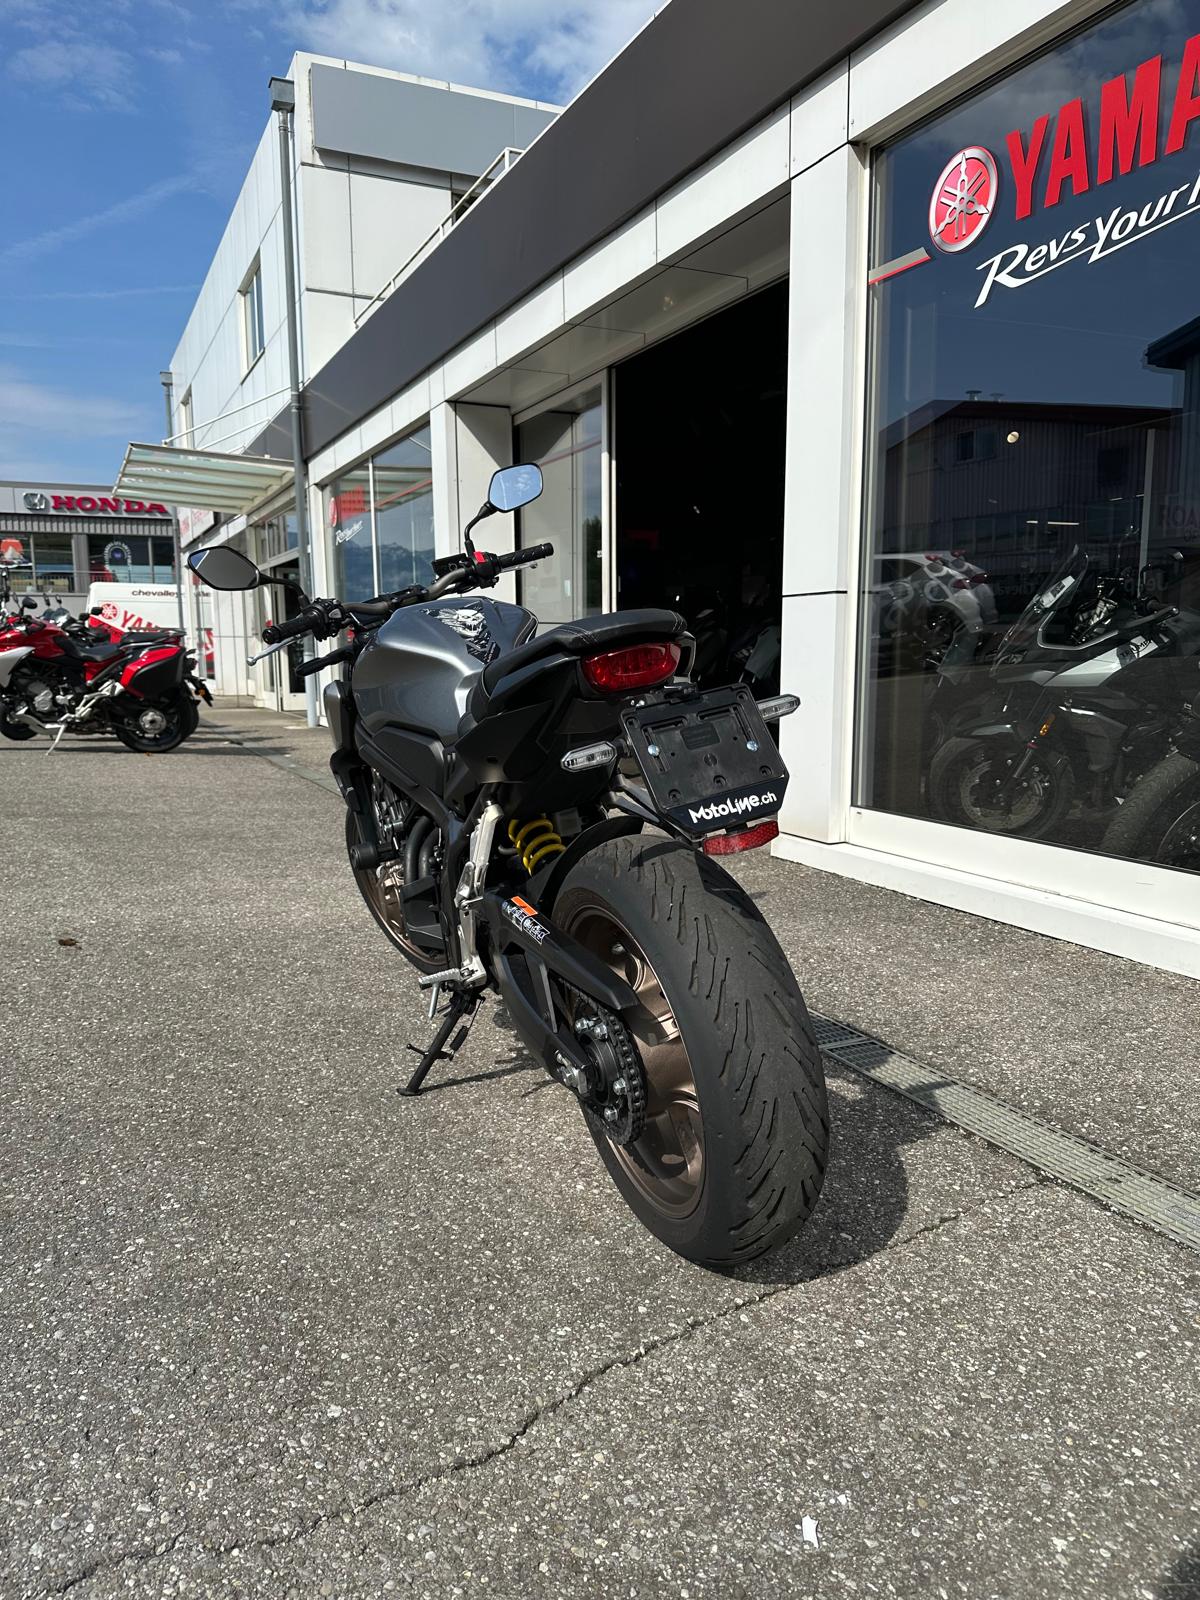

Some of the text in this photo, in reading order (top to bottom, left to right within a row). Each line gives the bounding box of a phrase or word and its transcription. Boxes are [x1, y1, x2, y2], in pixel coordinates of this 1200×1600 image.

[974, 222, 1091, 308] Revs
[1088, 183, 1191, 265] Your
[51, 495, 168, 513] HONDA
[688, 791, 778, 824] MotoLine.ch
